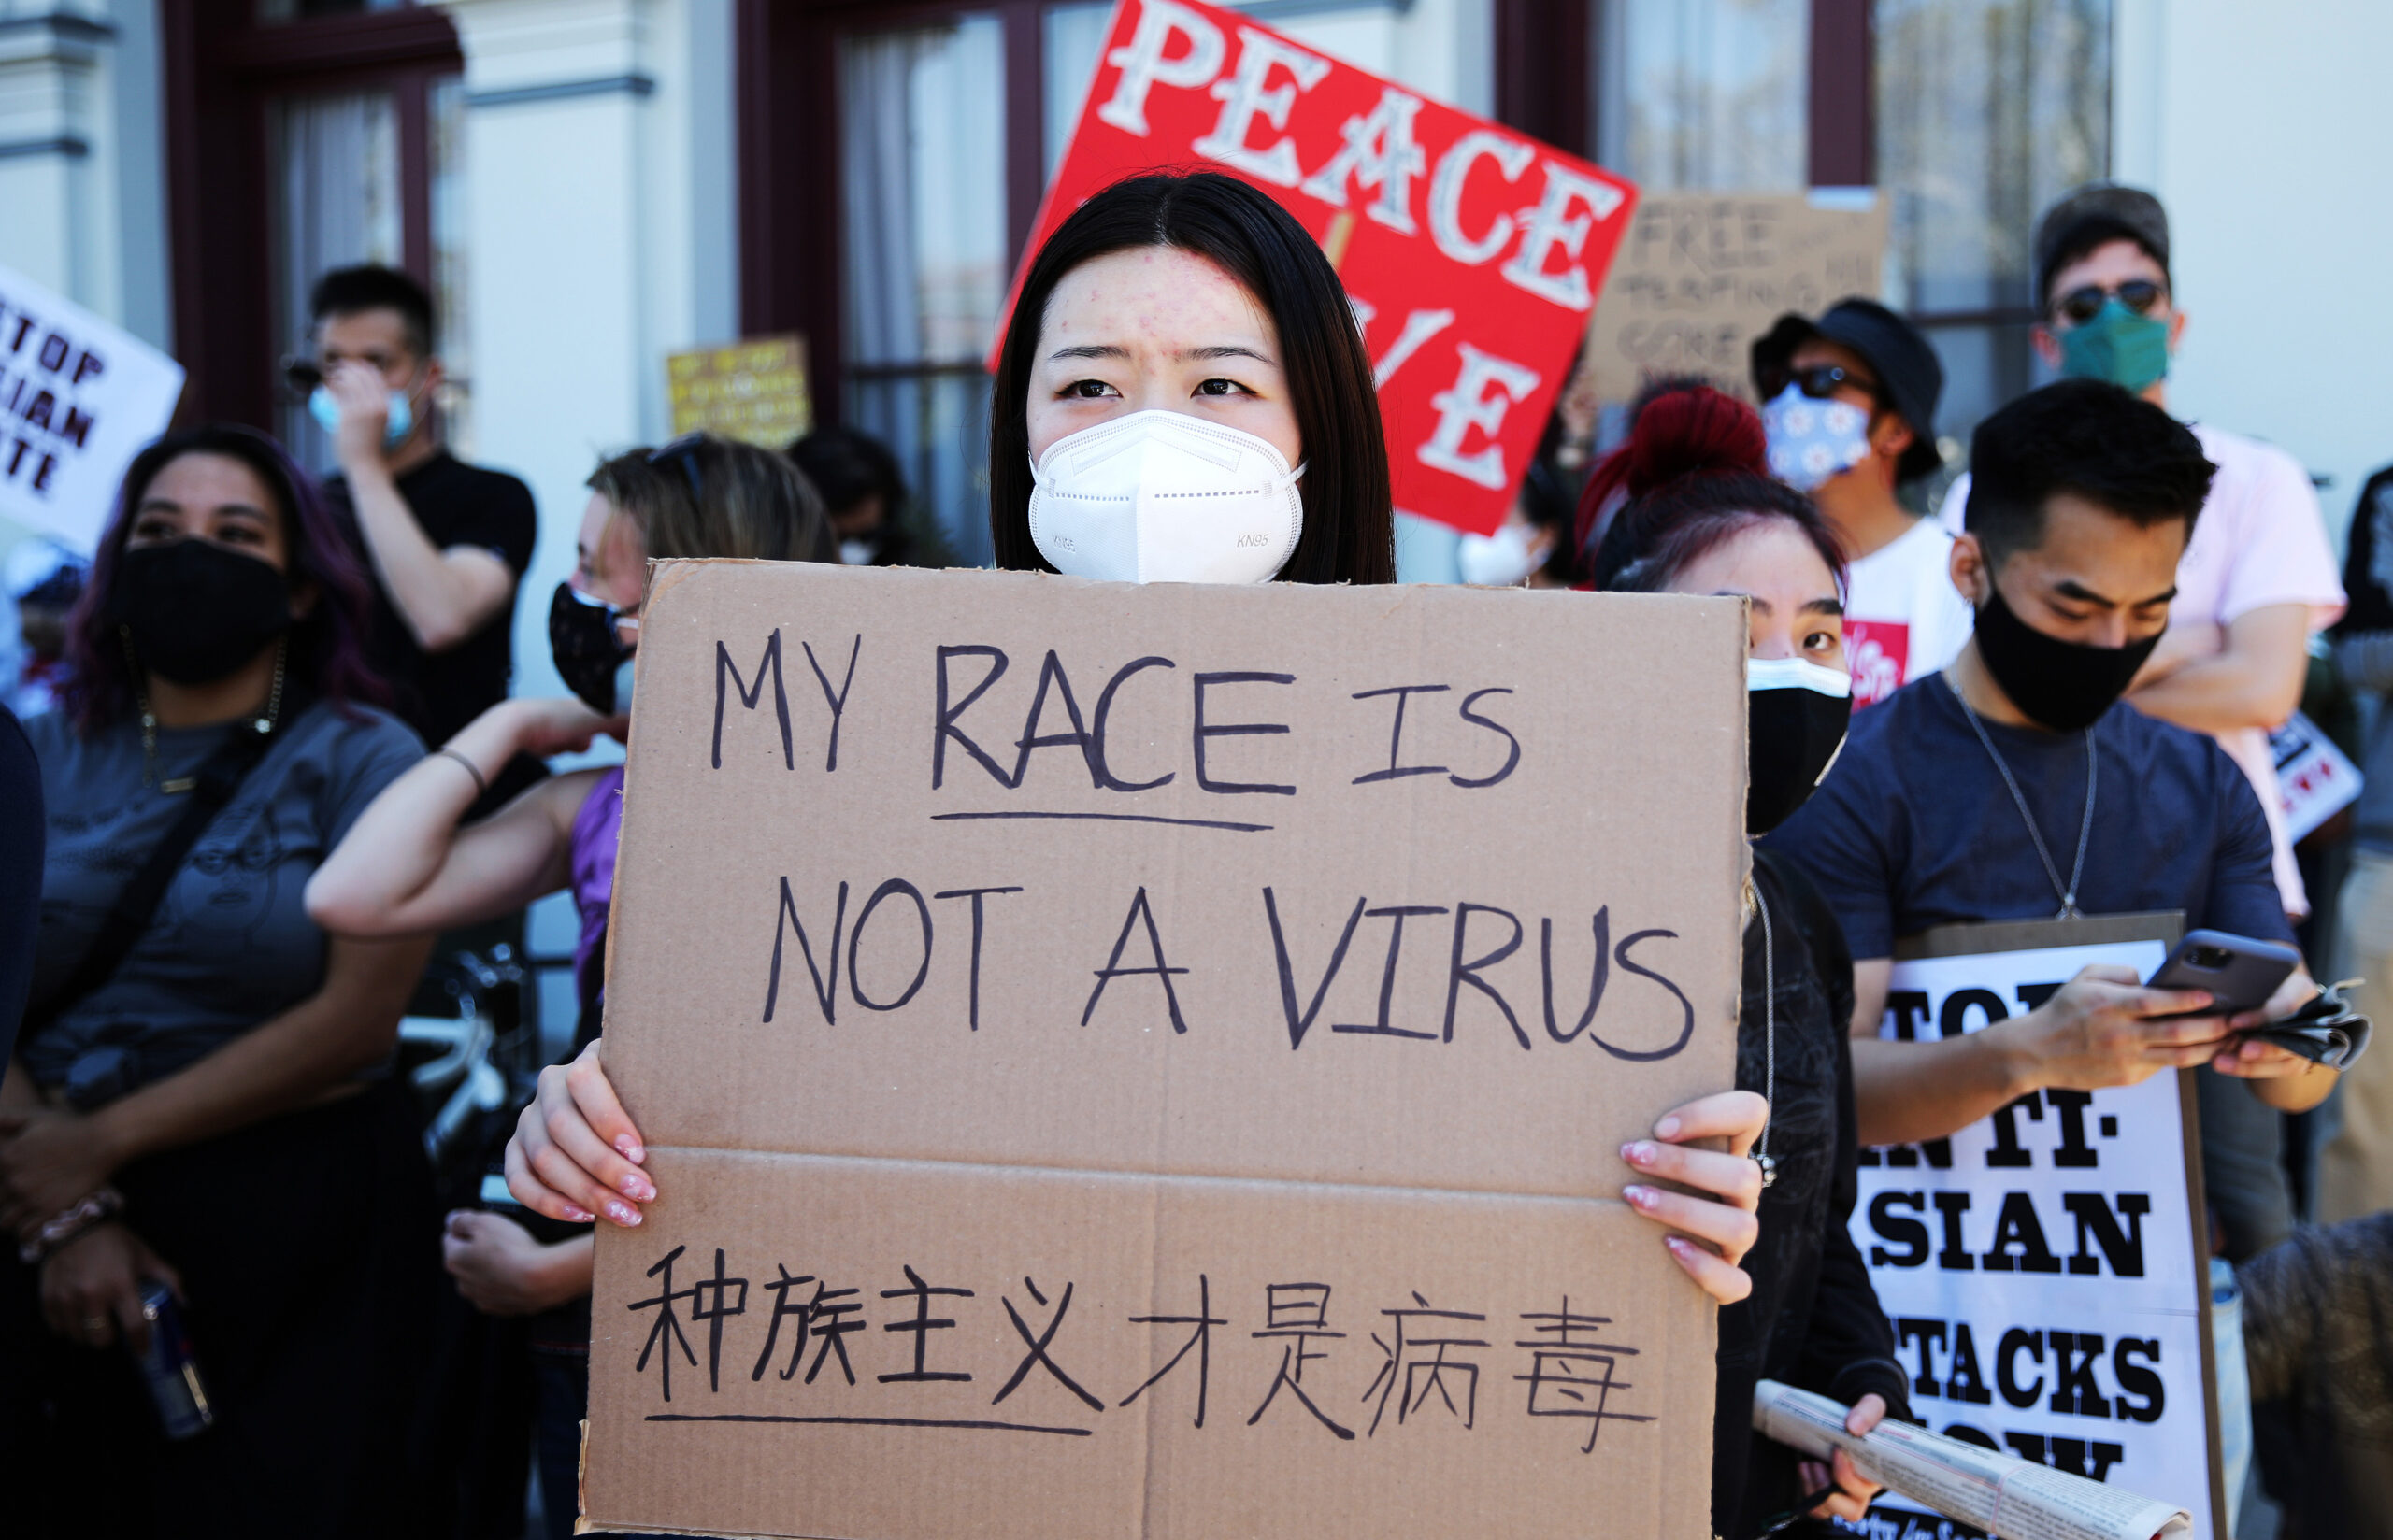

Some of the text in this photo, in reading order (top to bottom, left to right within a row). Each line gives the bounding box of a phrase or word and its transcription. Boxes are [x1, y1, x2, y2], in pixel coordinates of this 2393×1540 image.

[1097, 0, 1626, 311] PEACE
[0, 299, 104, 384] TOP
[0, 364, 94, 449] IAN
[1236, 534, 1269, 548] KN95
[712, 628, 1521, 795] MY RACE IS
[763, 876, 1695, 1062] NOT A VIRUS
[1868, 1191, 2152, 1277] SIAN
[1890, 1318, 2165, 1423] TACKS
